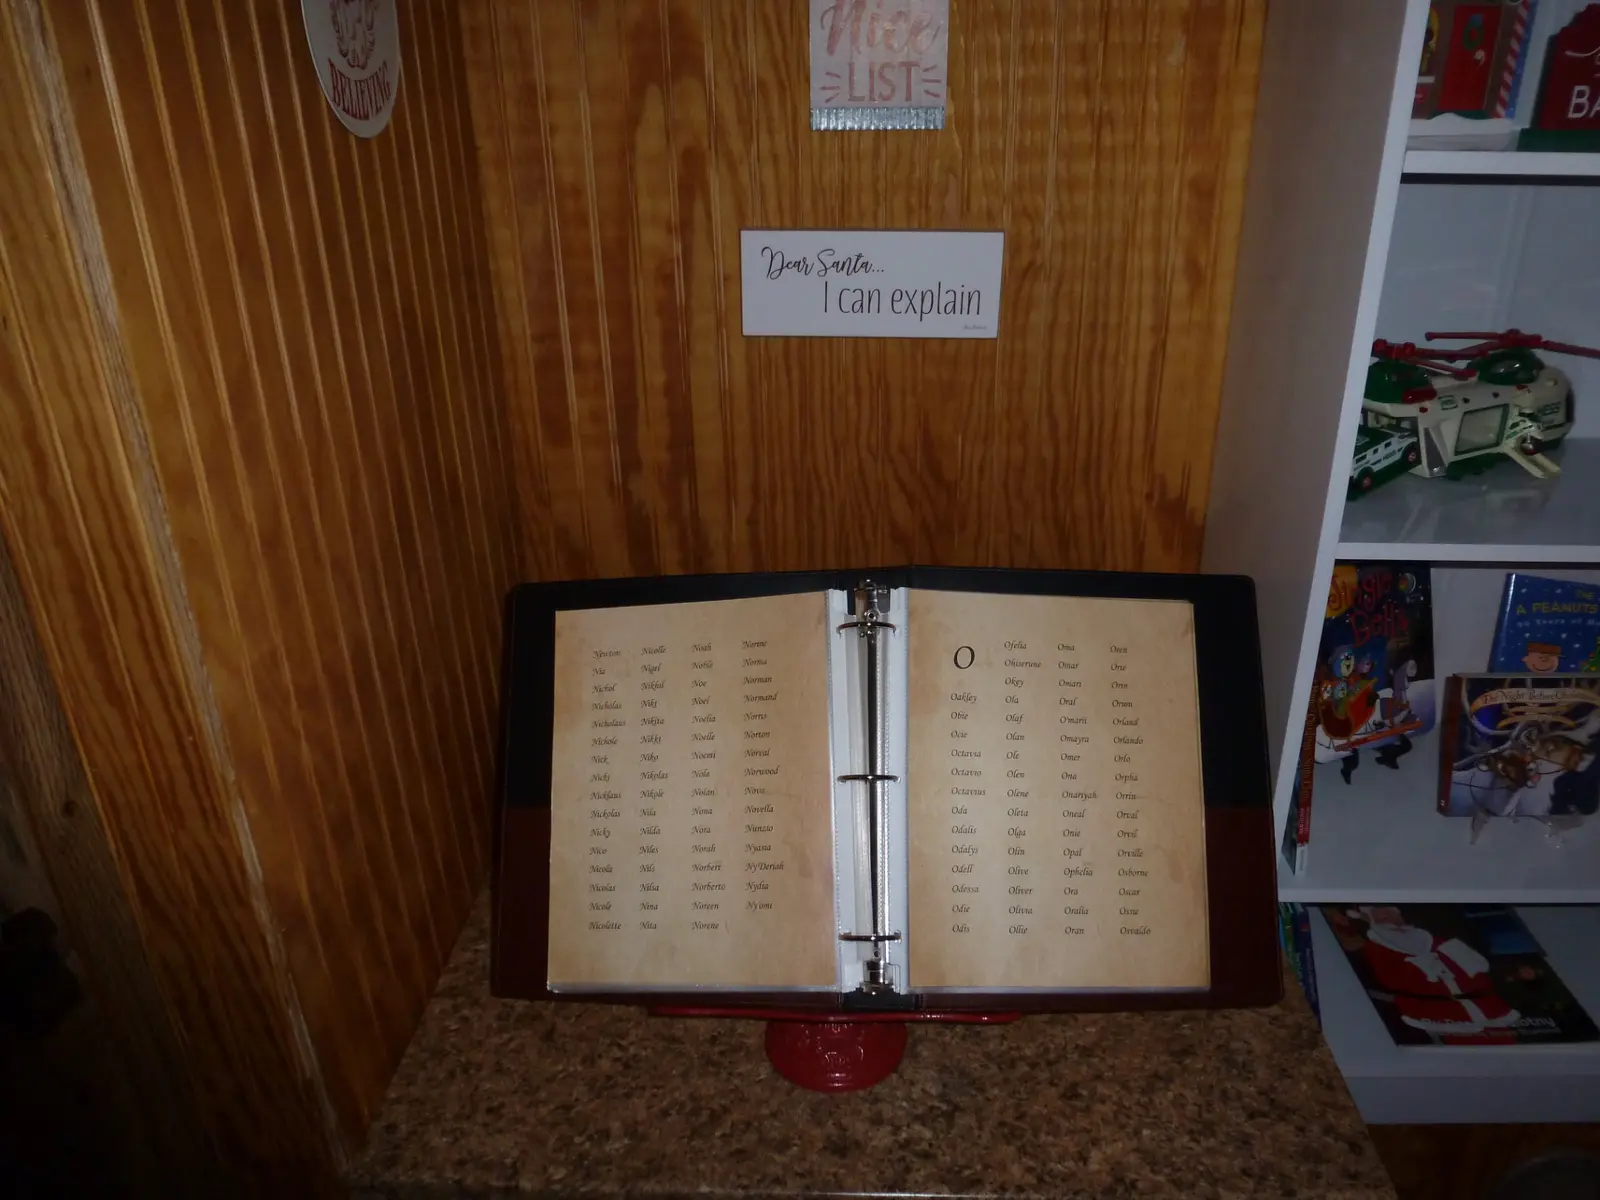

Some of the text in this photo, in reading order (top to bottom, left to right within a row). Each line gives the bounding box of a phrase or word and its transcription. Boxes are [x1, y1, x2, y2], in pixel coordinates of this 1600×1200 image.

[821, 0, 940, 56] Nice
[848, 61, 920, 102] LIST
[328, 57, 391, 120] BELIEVING
[761, 246, 884, 280] Dear Santa...
[824, 280, 981, 322] I can explain
[1532, 601, 1599, 614] PEANUTS
[691, 642, 712, 652] Noah
[1003, 640, 1027, 652] Ofelia
[1057, 643, 1075, 652] Oma
[742, 657, 768, 667] Norma
[954, 646, 975, 669] O
[1057, 661, 1079, 670] Omar
[591, 667, 606, 676] Nia
[691, 679, 707, 688] Noe
[743, 676, 773, 685] Norman
[1004, 676, 1024, 689] Okey
[691, 696, 709, 706] Noel
[743, 691, 779, 703] Normand
[950, 691, 977, 705] Oakley
[1004, 694, 1019, 704] Ola
[1059, 696, 1078, 706] Oral
[591, 700, 622, 710] Nicholas
[691, 713, 716, 724] Noelia
[950, 710, 969, 720] Obie
[1005, 713, 1025, 725] Olaf
[640, 716, 665, 727] Nikita
[691, 731, 716, 741] Noelle
[743, 730, 771, 740] Norton
[950, 729, 968, 739] Ocie
[1005, 731, 1025, 741] Olan
[591, 735, 618, 747] Nichole
[1059, 734, 1090, 746] Omayra
[1113, 735, 1144, 745] Orlando
[639, 751, 659, 763] Niko
[744, 747, 771, 758] Norval
[950, 748, 982, 758] Octavia
[1005, 750, 1020, 760] Ole
[1060, 752, 1081, 762] Omer
[1113, 753, 1131, 763] Orlo
[640, 770, 668, 781] Nikolas
[691, 768, 710, 778] Nola
[744, 764, 780, 777] Norwood
[950, 767, 982, 777] Octavio
[1006, 768, 1025, 779] Olen
[1060, 771, 1077, 780] Ona
[1114, 772, 1139, 784] Orpha
[639, 788, 664, 800] Nikole
[691, 788, 715, 797] Nolan
[951, 786, 986, 796] Octavius
[1006, 788, 1029, 798] Olene
[1115, 791, 1137, 800] Orrin
[639, 807, 657, 817] Nila
[691, 807, 713, 816] Nona
[744, 803, 774, 814] Novella
[951, 806, 968, 815] Oda
[1007, 807, 1029, 817] Oleta
[1062, 808, 1087, 818] Oneal
[590, 808, 621, 820] Nickolas
[1116, 810, 1138, 820] Orval
[590, 827, 611, 839] Nicky
[639, 825, 661, 836] Nilda
[691, 825, 711, 835] Nora
[951, 824, 977, 834] Odalis
[1007, 826, 1026, 839] Olga
[1062, 828, 1081, 837] Onie
[589, 846, 607, 856] Nico
[639, 844, 659, 854] Niles
[691, 843, 716, 853] Norah
[951, 843, 979, 857] Odalys
[1007, 846, 1025, 856] Olin
[1117, 848, 1144, 858] Orville
[1062, 847, 1082, 860] Opal
[589, 864, 613, 874] Nicola
[639, 863, 656, 873] Nils
[691, 862, 722, 872] Norbert
[951, 863, 974, 874] Odell
[1007, 865, 1029, 876] Olive
[1117, 867, 1148, 877] Osborne
[1063, 866, 1093, 879] Ophelia
[589, 883, 617, 892] Nicolas
[691, 881, 726, 891] Norberto
[745, 880, 769, 893] Nydia
[951, 883, 979, 894] Odessa
[1008, 885, 1033, 895] Oliver
[1063, 886, 1079, 896] Ora
[1118, 887, 1141, 896] Oscar
[589, 901, 612, 911] Nicole
[639, 902, 659, 911] Nina
[691, 901, 719, 910] Noreen
[951, 903, 971, 913] Odie
[1008, 904, 1033, 915] Olivia
[1064, 905, 1089, 915] Oralia
[588, 920, 622, 930] Nicolette
[639, 920, 657, 930] Nita
[951, 923, 970, 933] Odis
[1008, 924, 1028, 935] Ollie
[1064, 926, 1085, 935] Oran
[1119, 925, 1151, 936] Osvaldo
